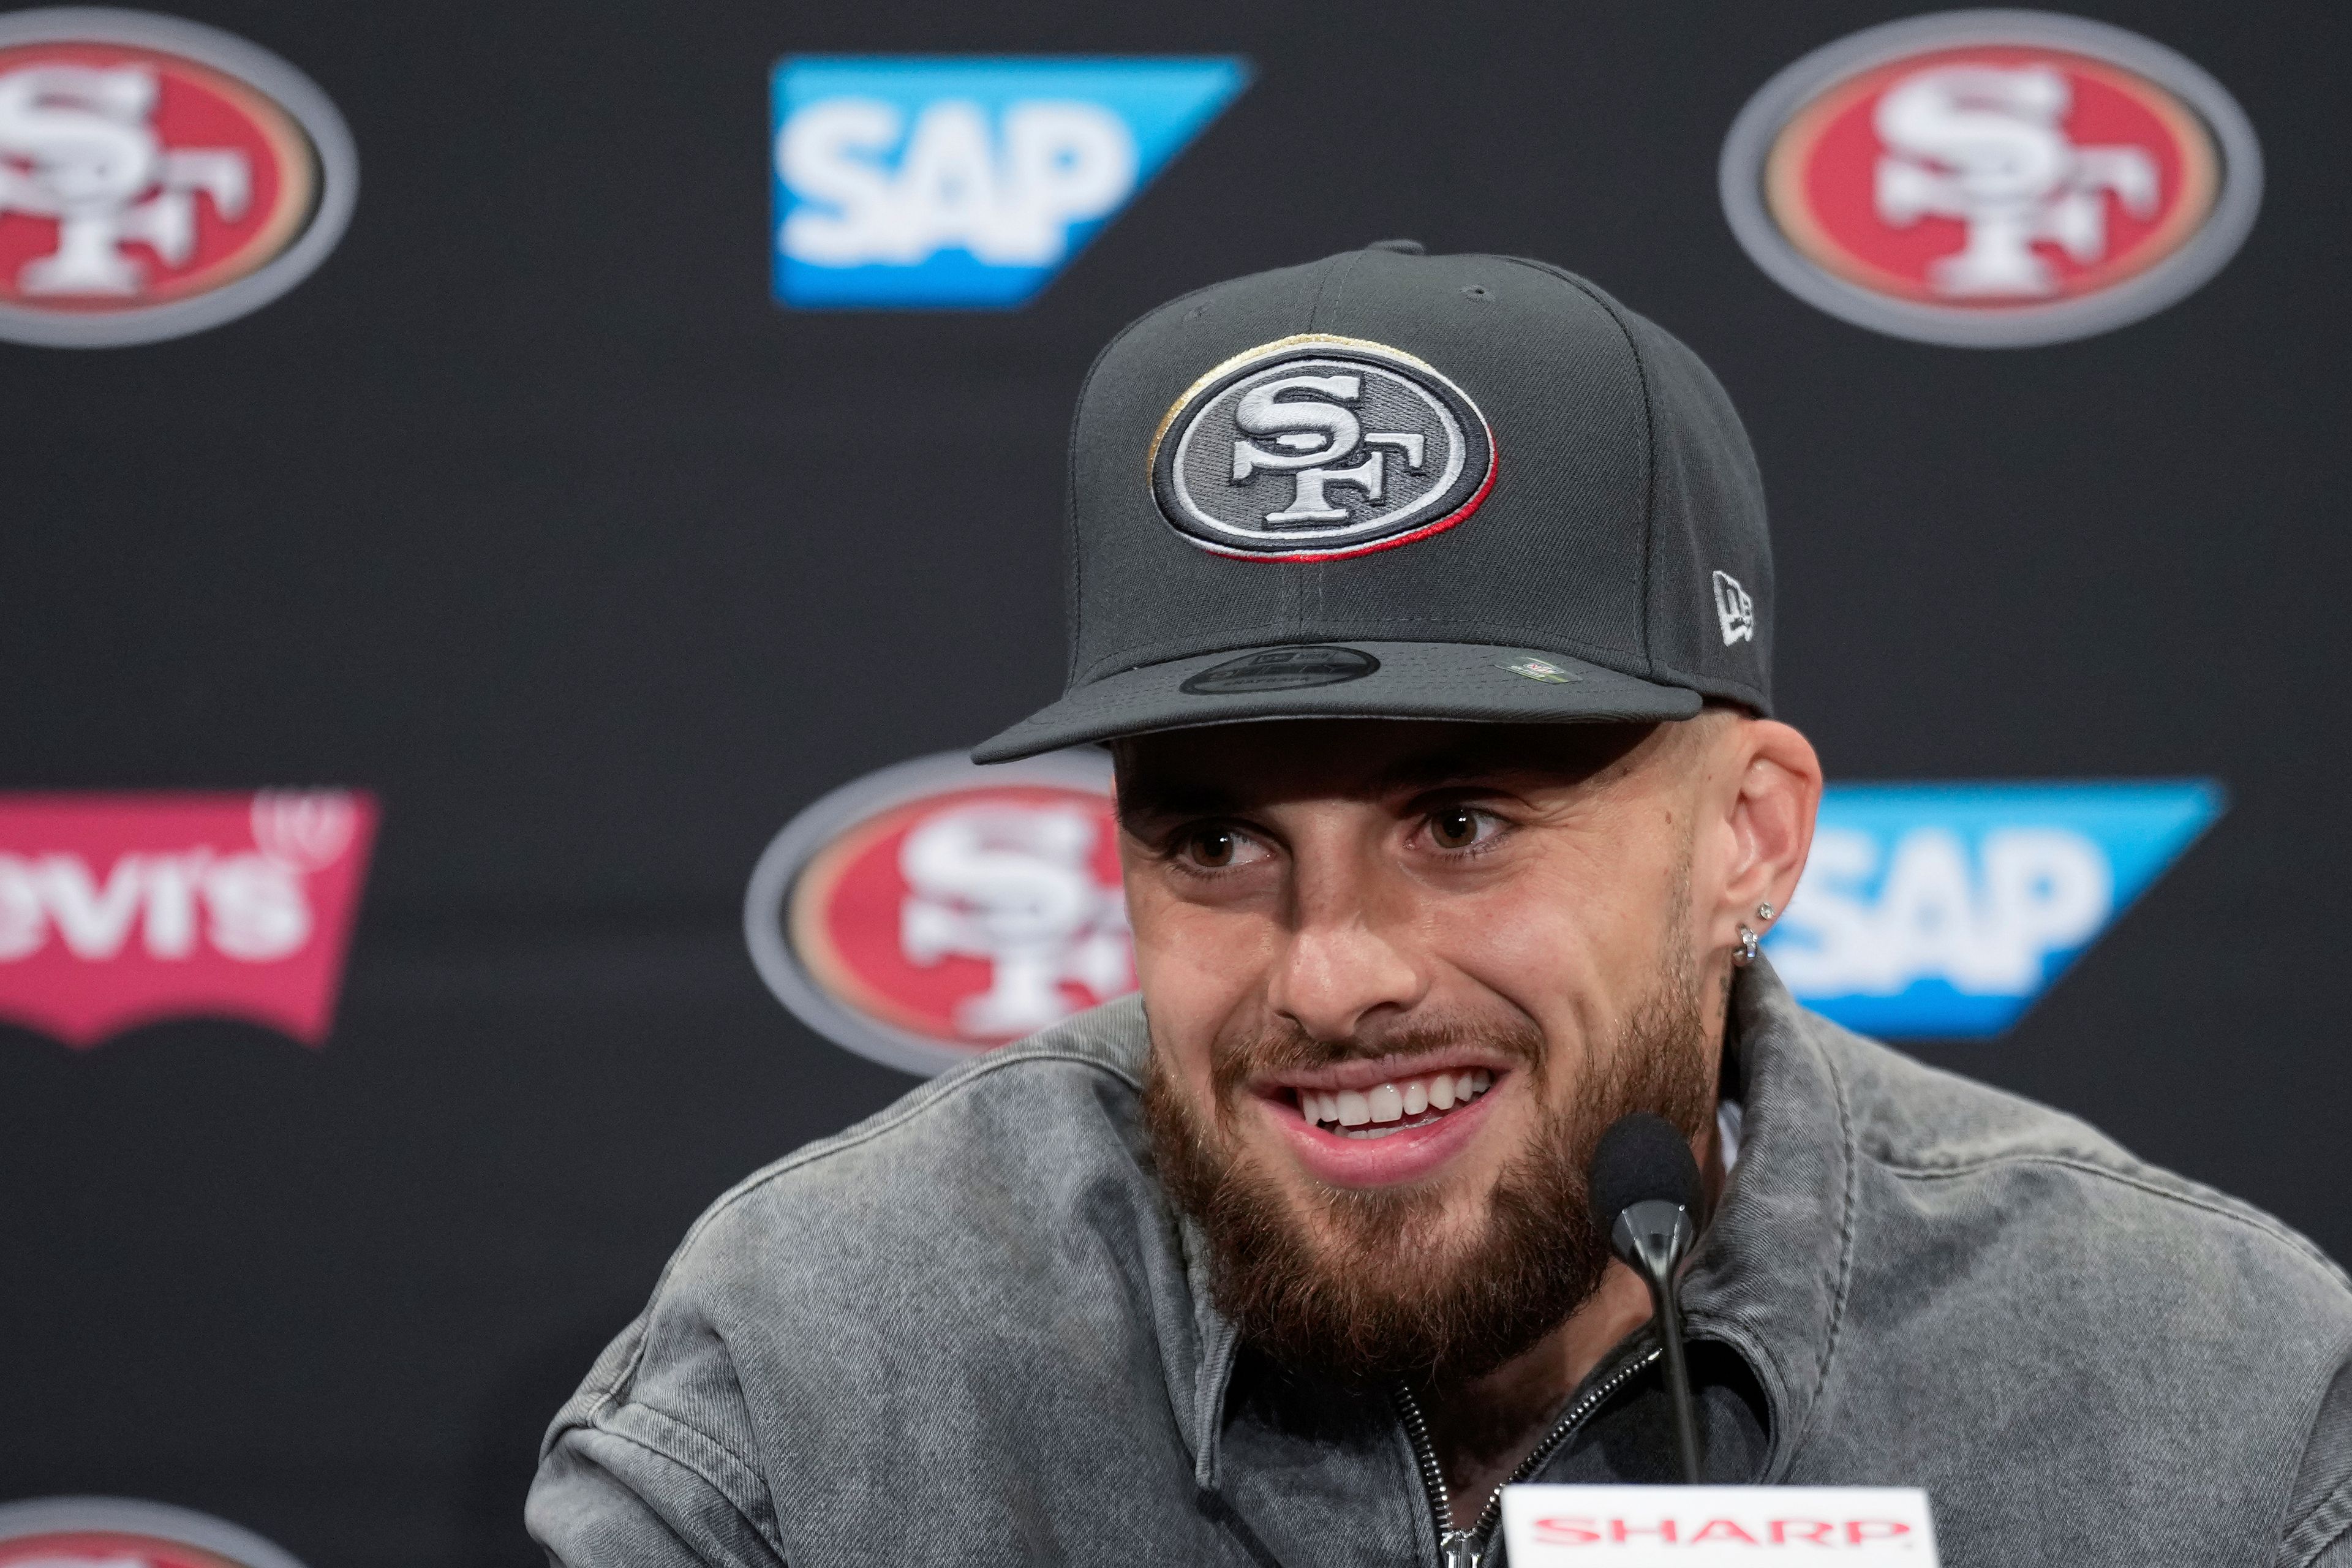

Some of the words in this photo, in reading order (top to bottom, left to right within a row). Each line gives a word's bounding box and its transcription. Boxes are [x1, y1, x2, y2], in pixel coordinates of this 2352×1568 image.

[775, 97, 1137, 268] SAP
[1873, 64, 2162, 298] SF
[1232, 375, 1425, 526] SF
[1763, 826, 2113, 998] SAP
[1533, 1518, 1911, 1547] SHARP
